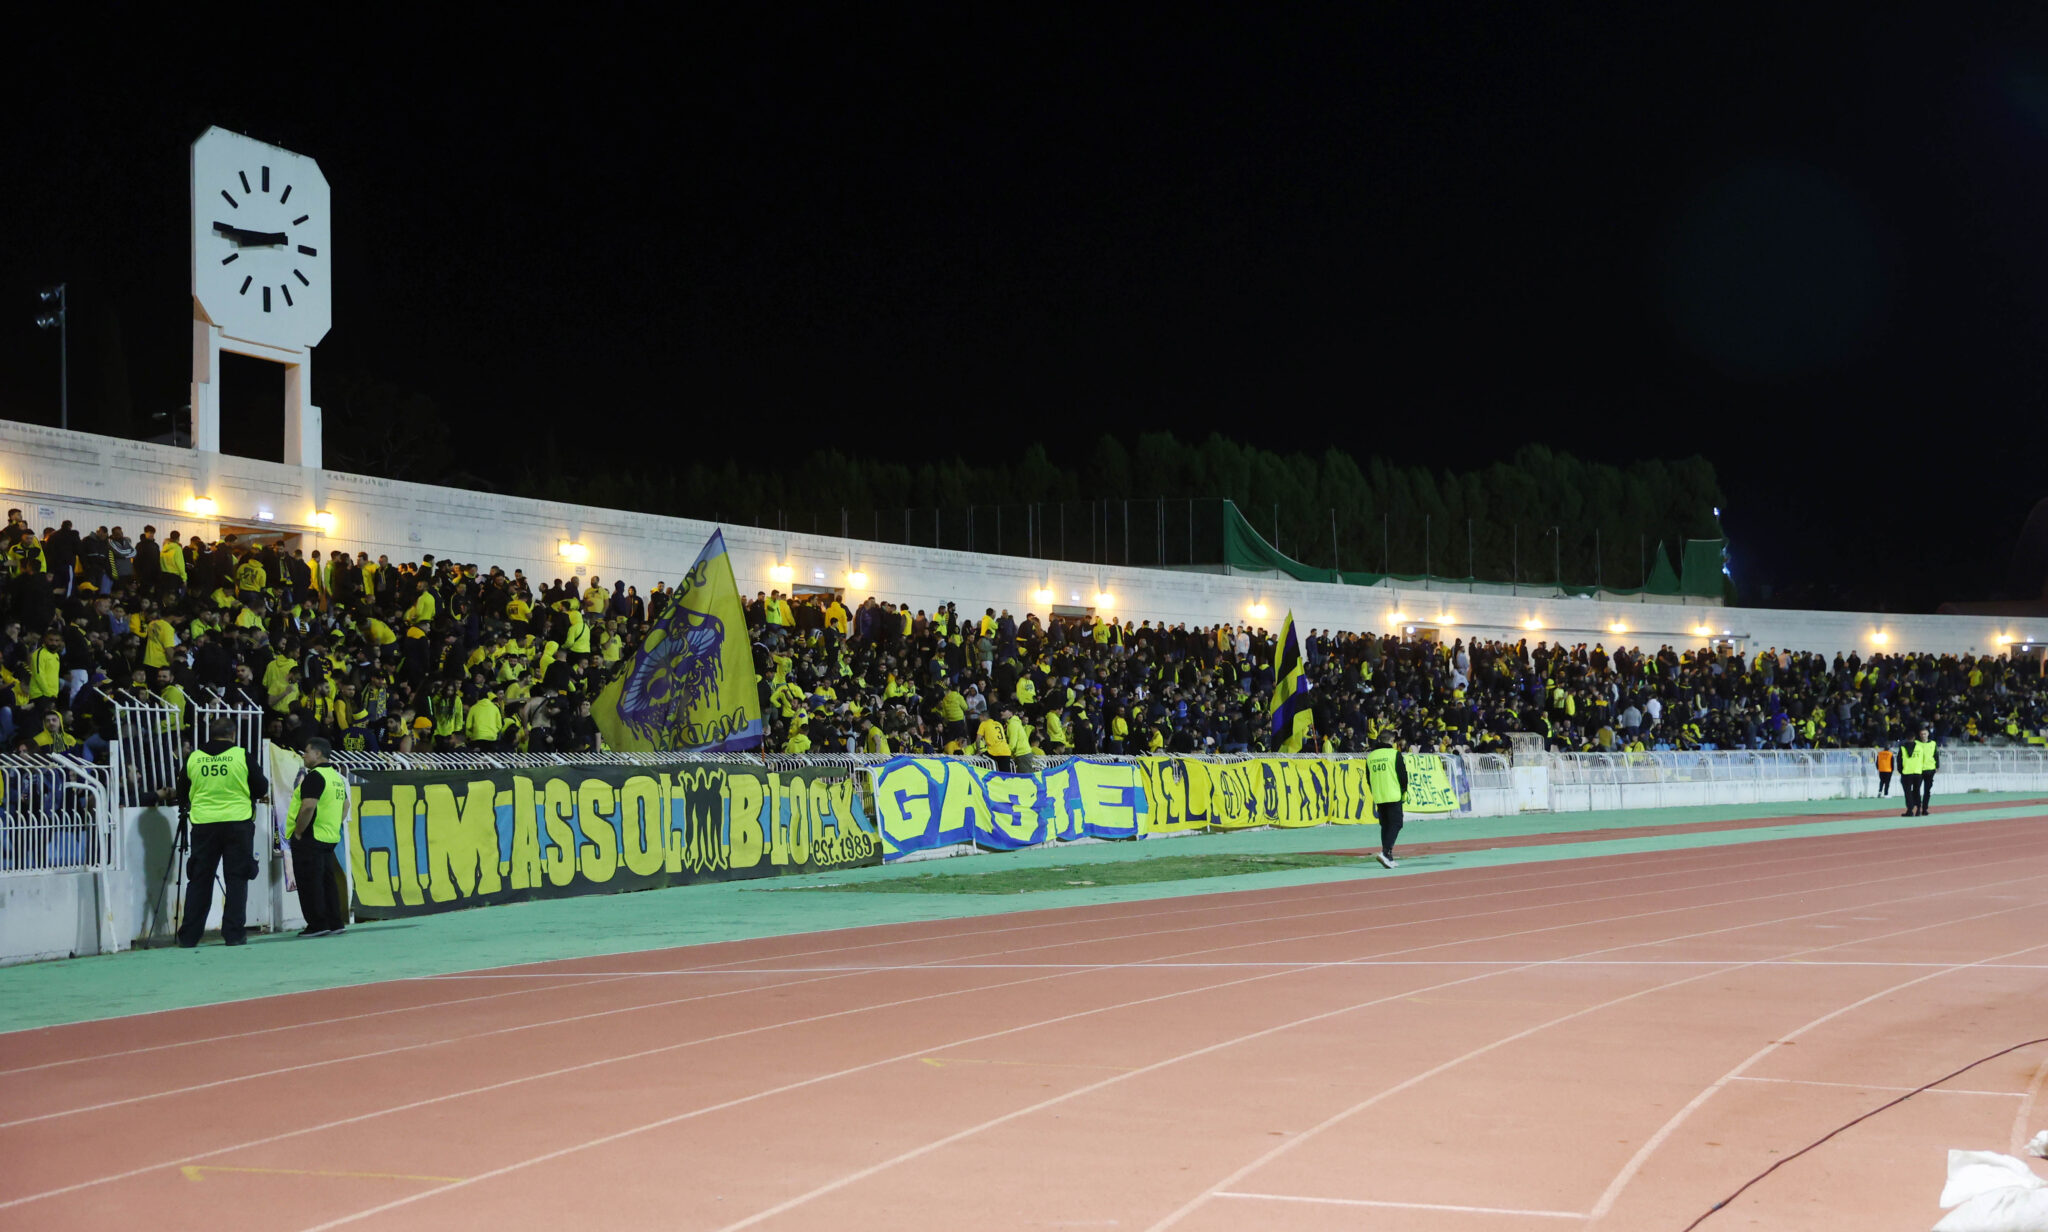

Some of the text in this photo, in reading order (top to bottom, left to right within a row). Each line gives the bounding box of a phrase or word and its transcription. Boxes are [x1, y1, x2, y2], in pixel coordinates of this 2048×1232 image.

[201, 764, 228, 777] 056
[1372, 763, 1387, 773] 040
[1139, 758, 1380, 825] YELLOW FANATI
[350, 773, 864, 907] LIMASSOL BLOCK
